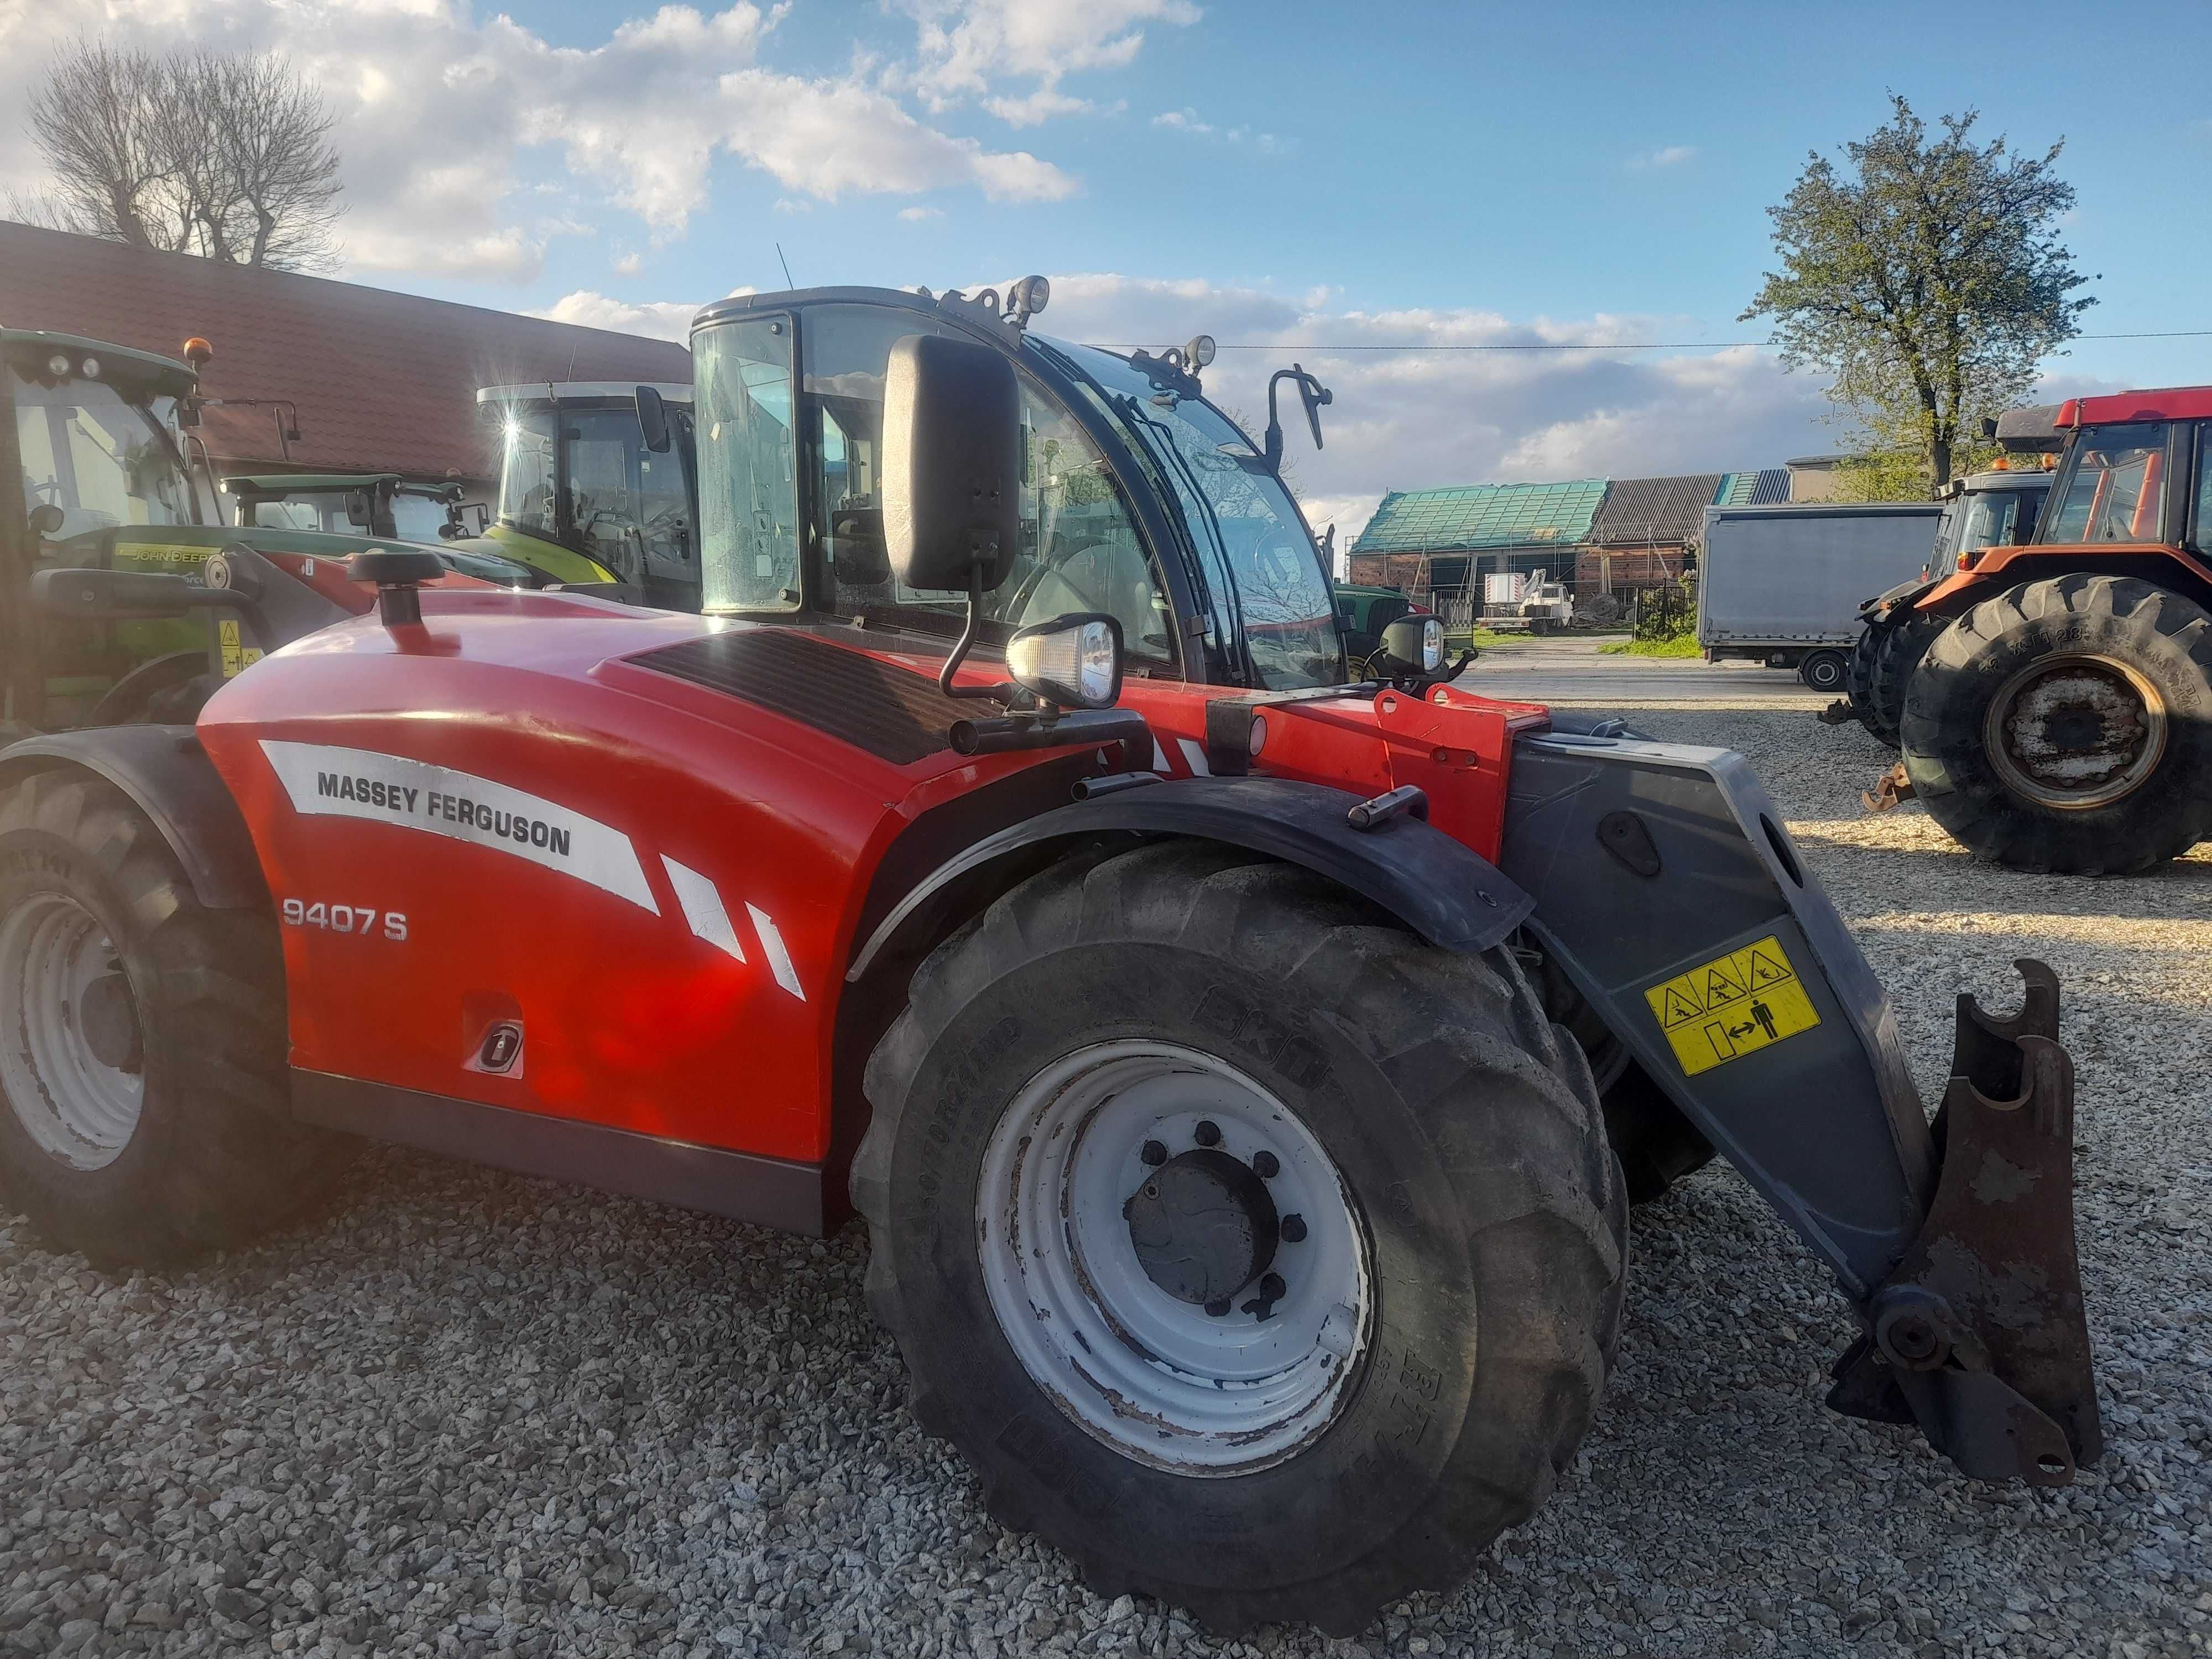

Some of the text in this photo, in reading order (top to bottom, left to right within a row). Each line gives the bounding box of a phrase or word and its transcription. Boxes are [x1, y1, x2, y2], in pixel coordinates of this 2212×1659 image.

[132, 550, 211, 563] JOHN DEER
[317, 771, 571, 857] MASSEY FERGUSON
[283, 898, 408, 941] 9407 S
